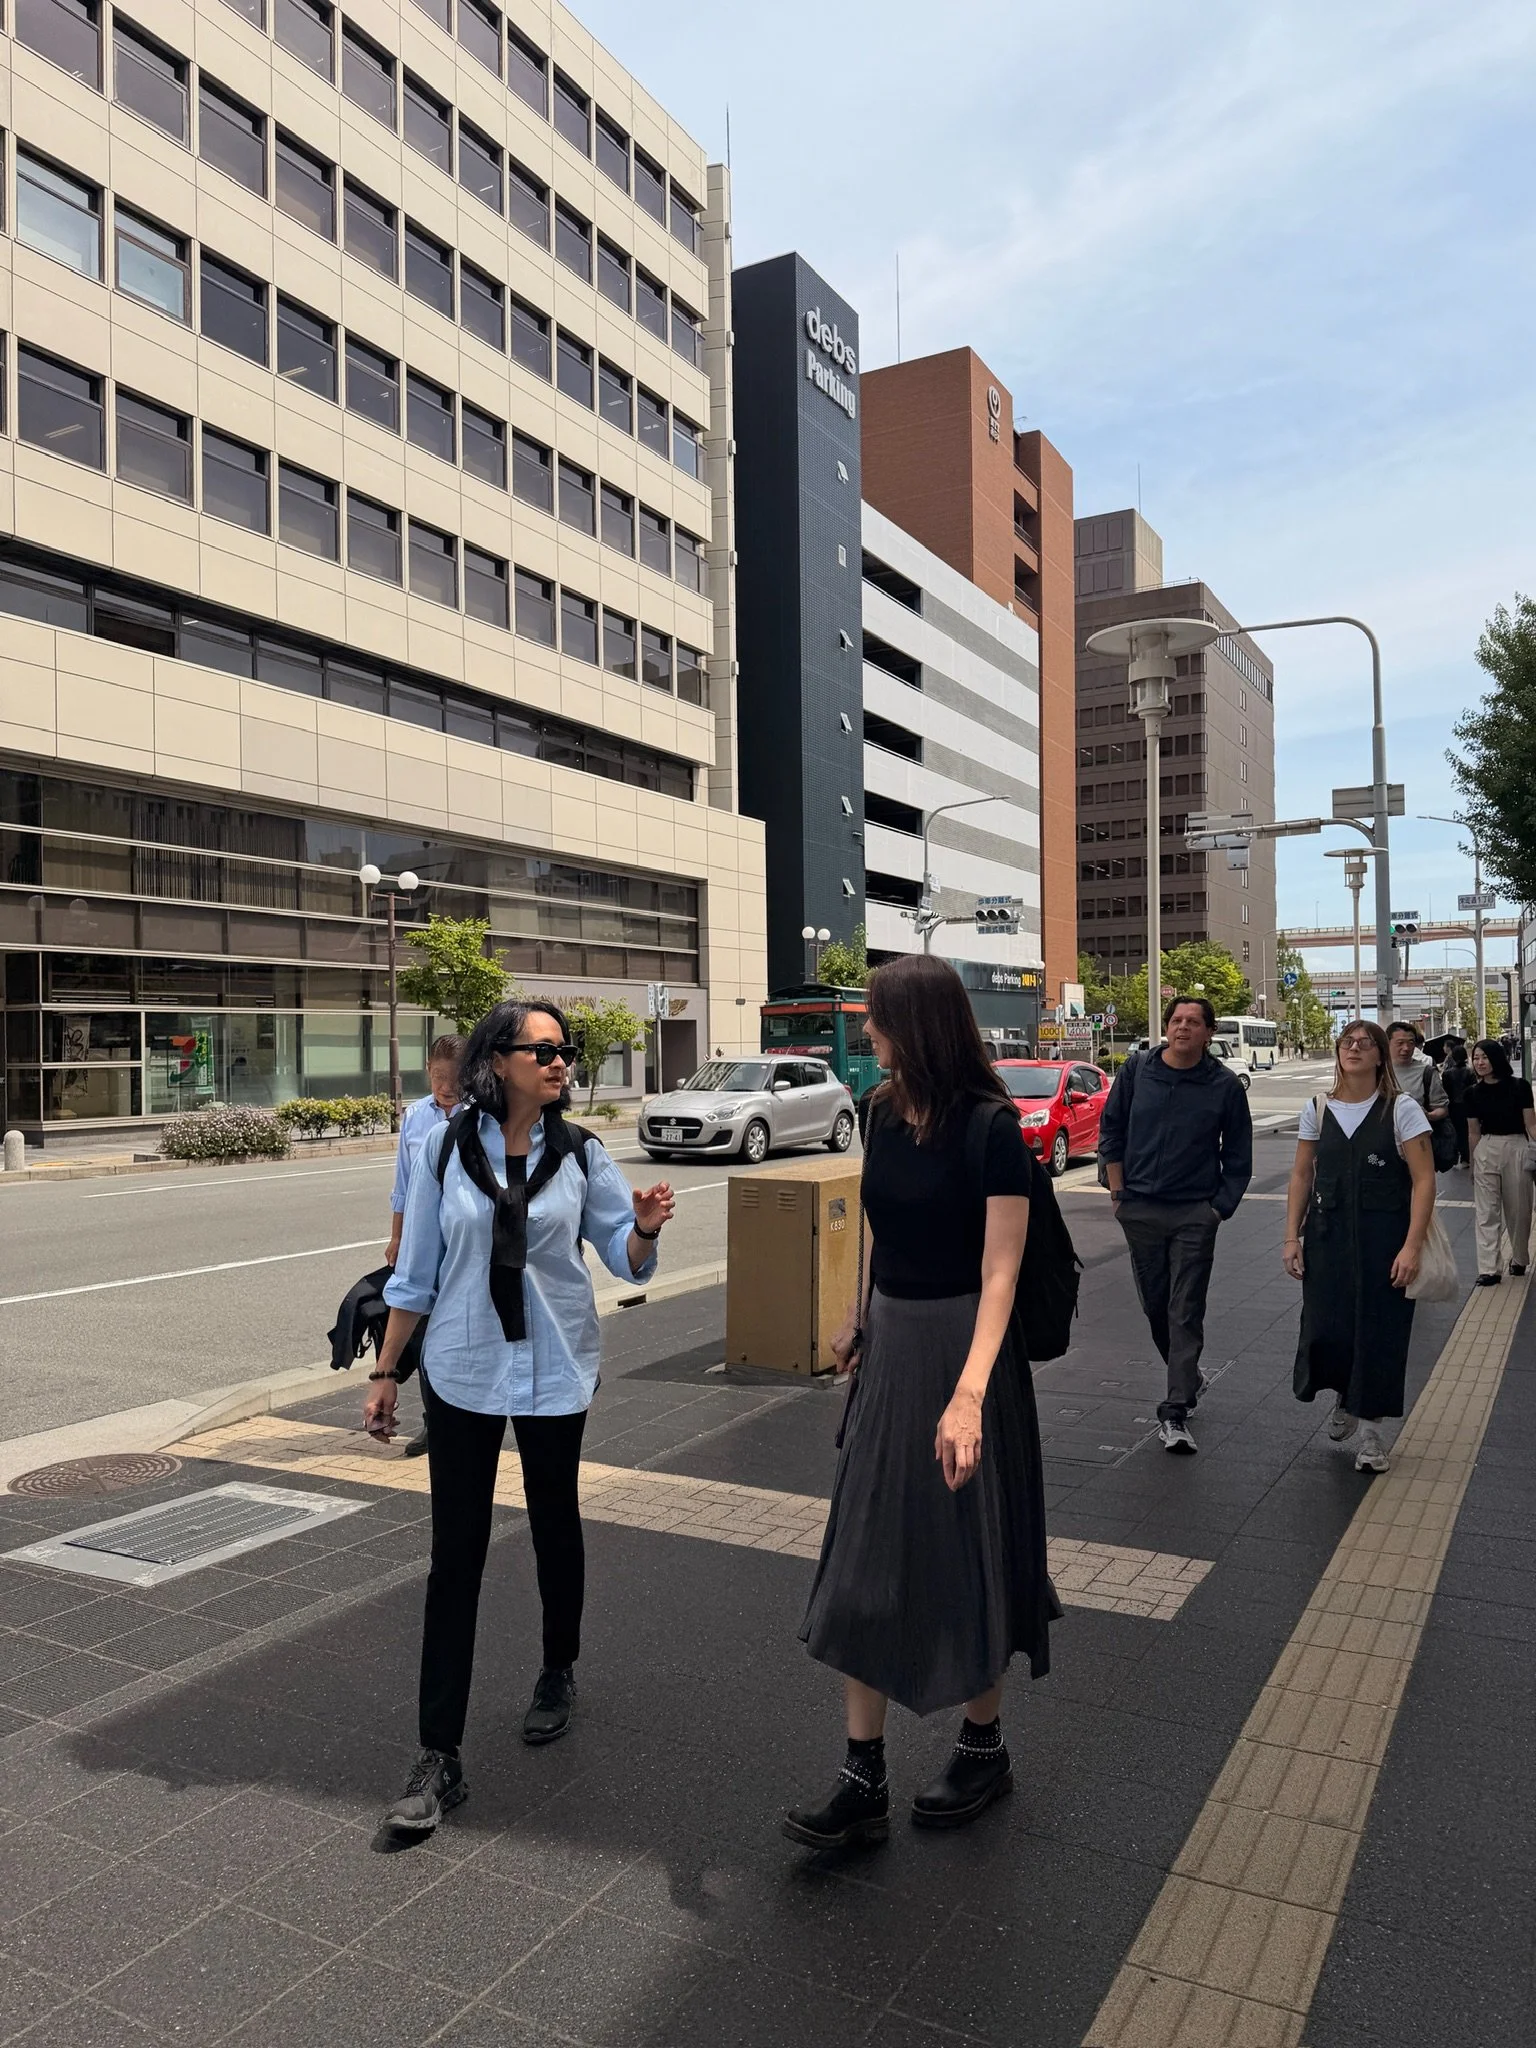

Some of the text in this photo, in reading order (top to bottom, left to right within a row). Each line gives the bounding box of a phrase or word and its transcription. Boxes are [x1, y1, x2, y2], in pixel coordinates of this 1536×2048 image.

[806, 306, 856, 375] debs
[806, 349, 856, 419] Parking
[991, 971, 1003, 984] debs
[1004, 973, 1021, 988] Parking
